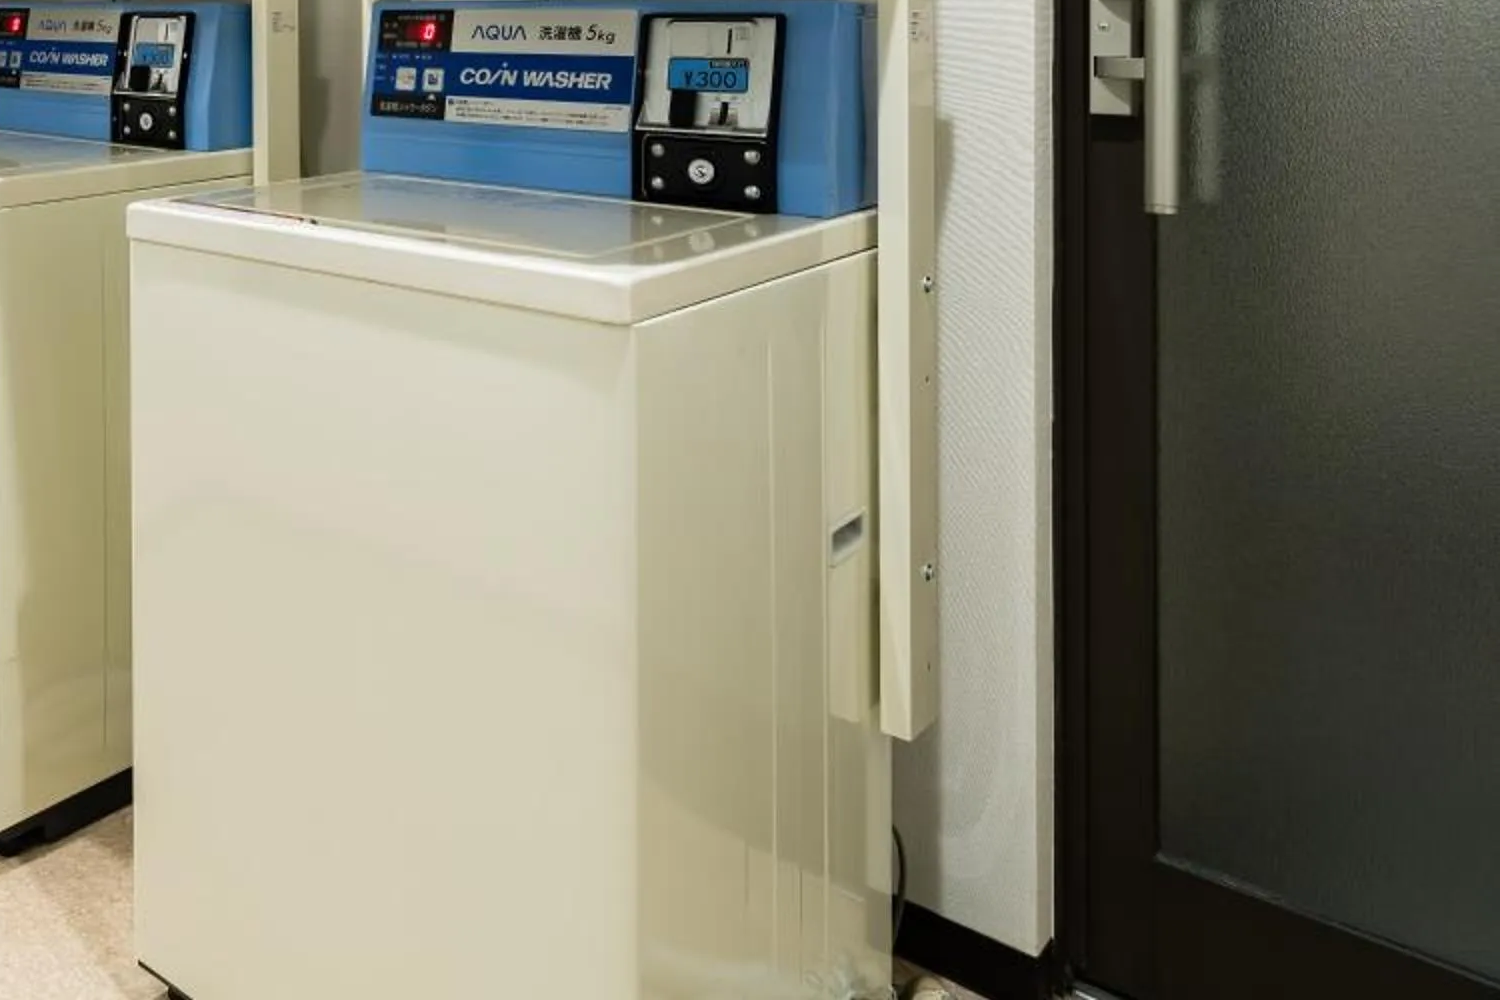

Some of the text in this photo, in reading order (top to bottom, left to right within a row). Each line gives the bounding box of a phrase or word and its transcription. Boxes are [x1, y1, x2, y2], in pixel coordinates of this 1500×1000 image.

[423, 23, 436, 39] 0
[471, 23, 616, 45] AQUA 洗濯機 5kg
[61, 50, 110, 68] WASHER
[459, 61, 613, 92] COIN WASHER
[684, 71, 737, 89] ¥300
